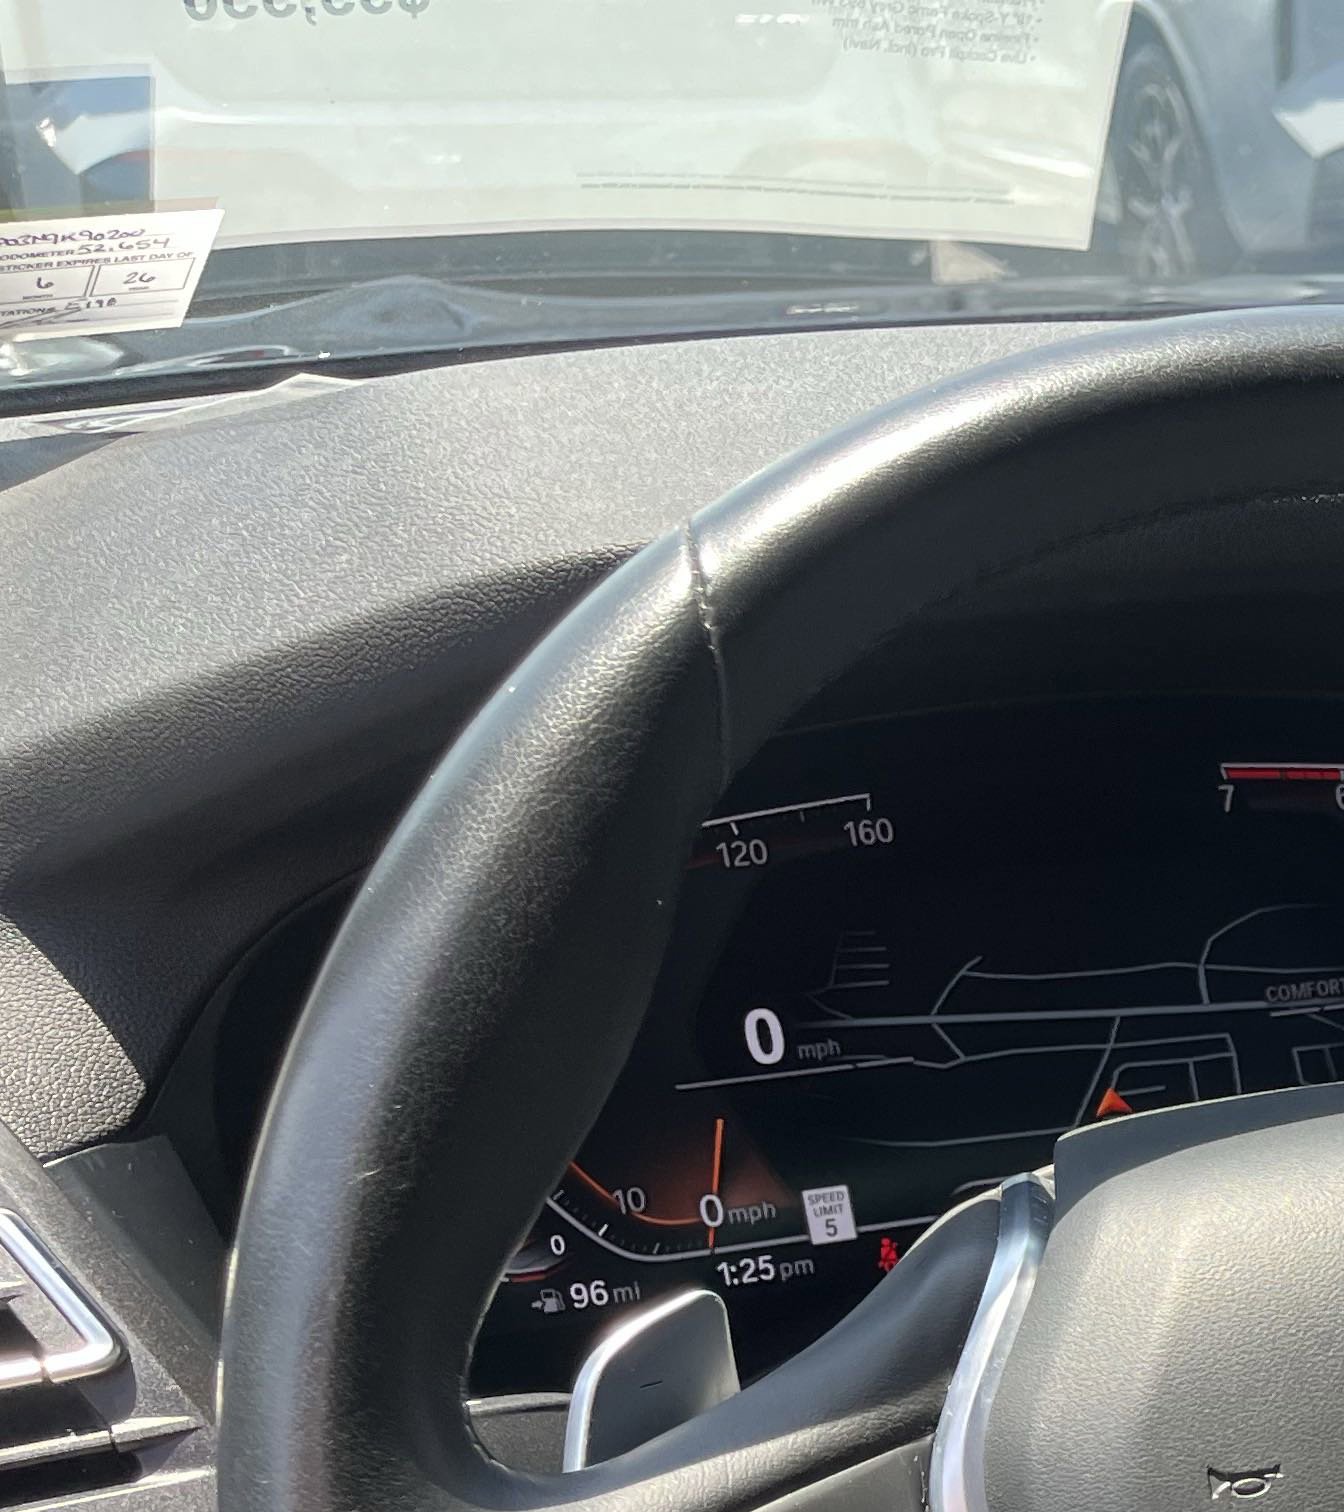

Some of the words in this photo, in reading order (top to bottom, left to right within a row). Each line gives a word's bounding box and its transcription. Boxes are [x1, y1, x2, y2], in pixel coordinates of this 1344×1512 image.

[114, 254, 146, 263] LAST
[1218, 784, 1235, 813] 7
[843, 817, 894, 849] 160
[715, 838, 768, 868] 120
[743, 1007, 785, 1065] 0
[797, 1036, 841, 1061] mph
[611, 1185, 647, 1215] 10
[699, 1193, 725, 1228] 0
[727, 1201, 777, 1226] mph
[807, 1190, 845, 1206] SPEED
[812, 1203, 844, 1218] LIMIT
[825, 1218, 838, 1238] 5
[550, 1234, 566, 1256] 0
[716, 1254, 776, 1287] 1:25
[779, 1256, 815, 1283] pm
[569, 1279, 610, 1310] 96
[610, 1282, 642, 1303] mi
